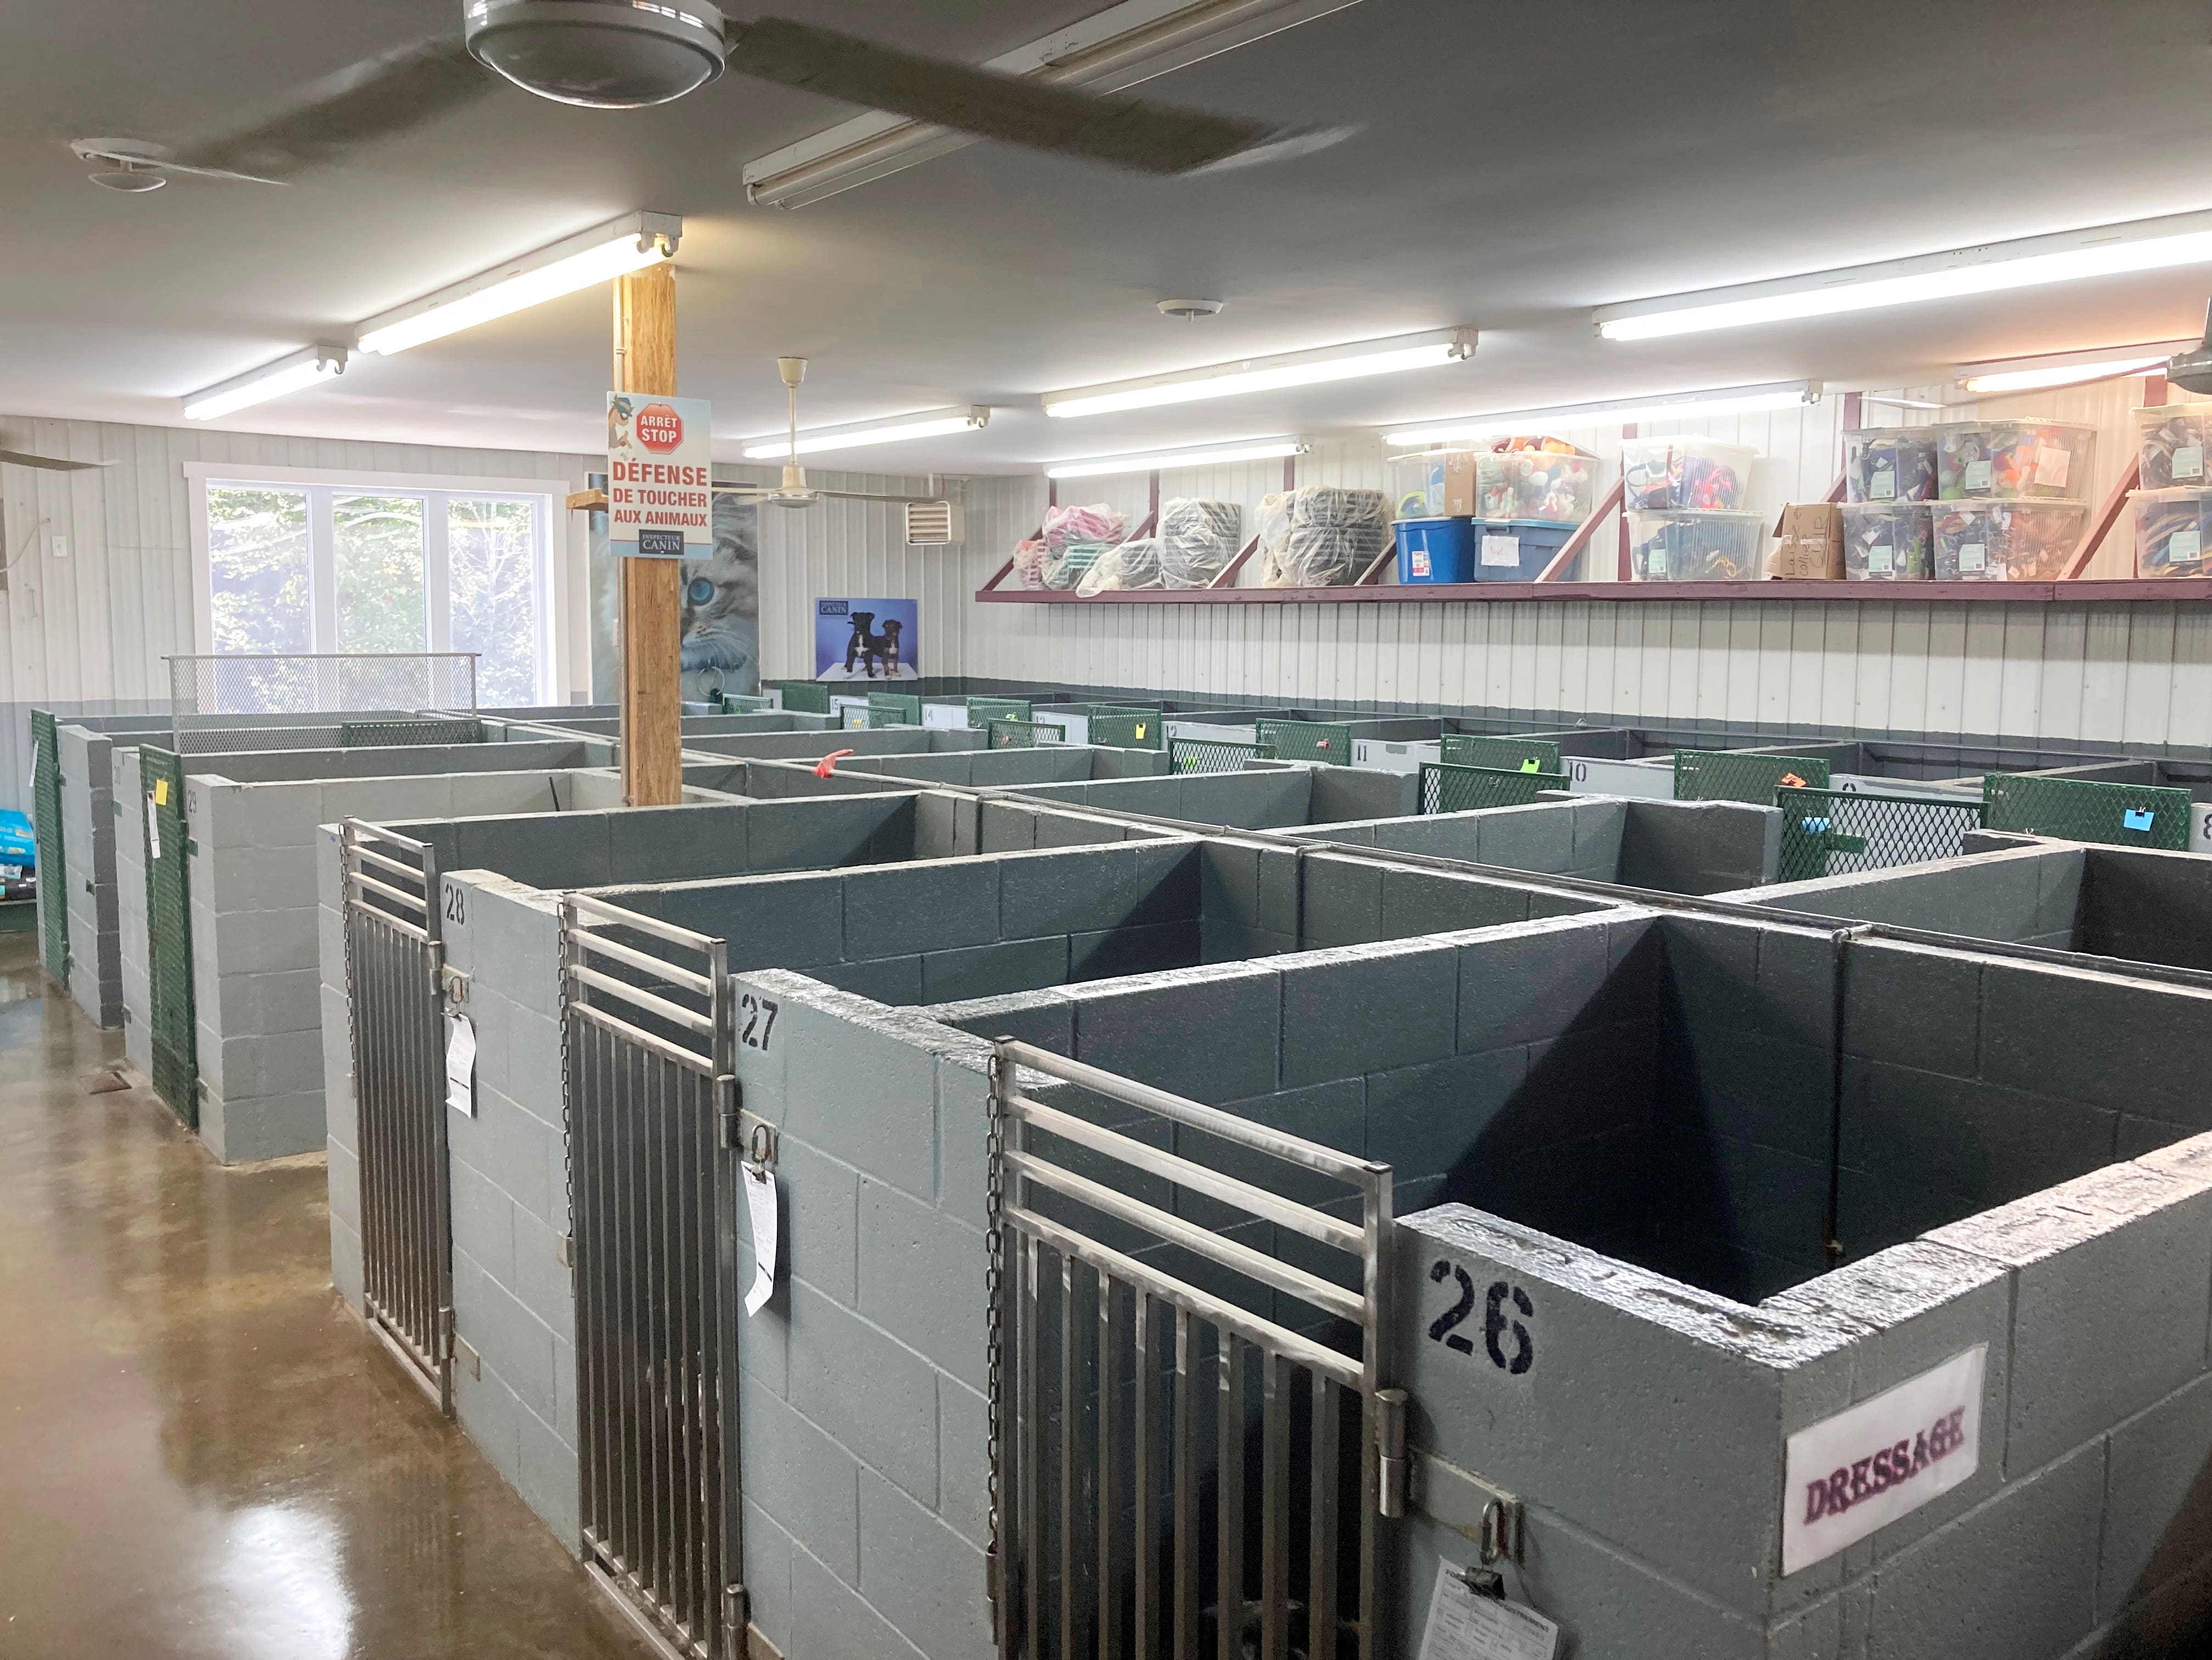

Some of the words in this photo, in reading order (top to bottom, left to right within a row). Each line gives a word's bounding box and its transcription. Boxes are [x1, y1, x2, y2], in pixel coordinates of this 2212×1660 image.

[641, 415, 678, 429] ARRÊT
[641, 429, 677, 443] STOP
[613, 458, 707, 486] DÉFENSE
[613, 488, 633, 503] DE
[638, 489, 707, 507] TOUCHER
[614, 509, 641, 524] AUX
[645, 511, 707, 527] ANIMAUX
[643, 540, 680, 550] CANIN
[821, 606, 847, 614] CANIN
[832, 698, 838, 711] 15
[925, 708, 933, 721] 14
[1357, 744, 1367, 762] 11
[1570, 762, 1586, 781] 10
[188, 790, 196, 813] 29
[445, 884, 465, 926] 28
[742, 993, 778, 1051] 27
[1429, 1259, 1534, 1375] 26
[1803, 1405, 1966, 1527] DRESSAGE
